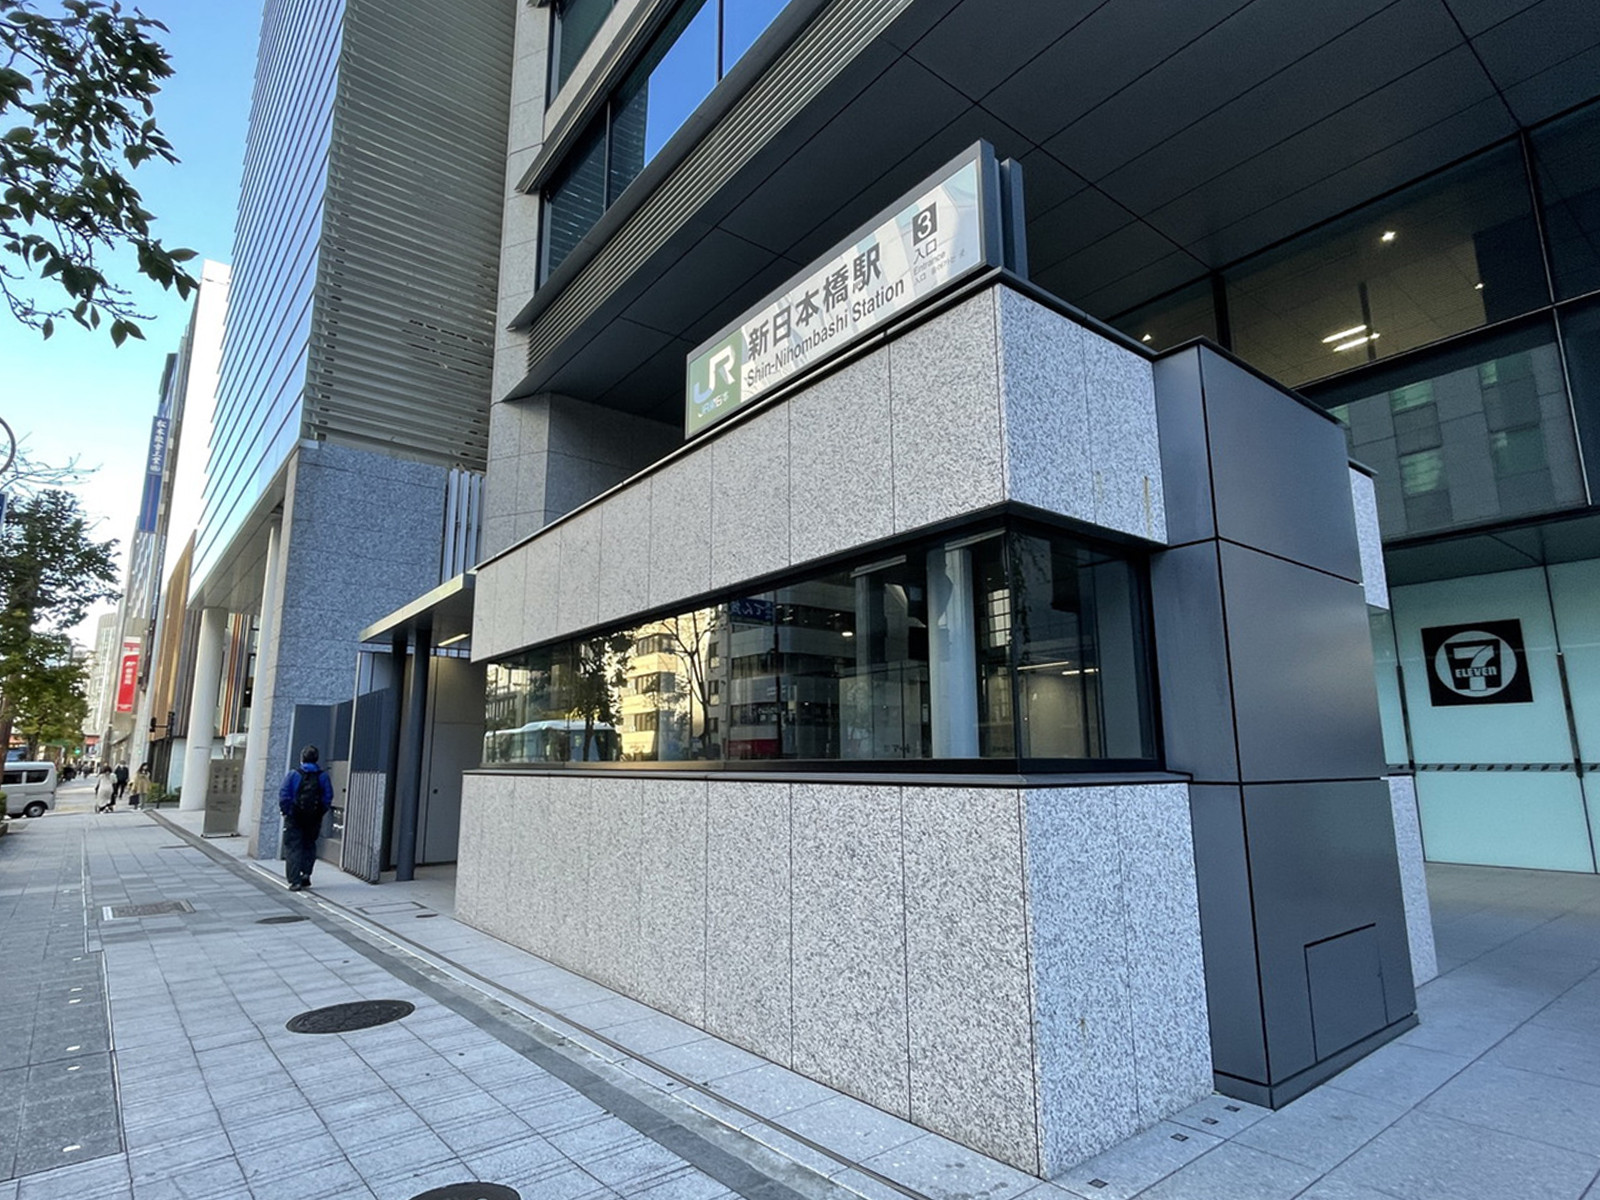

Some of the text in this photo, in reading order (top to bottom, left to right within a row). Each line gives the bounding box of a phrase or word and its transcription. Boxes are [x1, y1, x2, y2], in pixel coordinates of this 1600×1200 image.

[917, 210, 932, 239] 3
[913, 238, 937, 265] 入口
[914, 251, 946, 275] Entrance
[748, 242, 881, 361] 新日本橋駅
[747, 278, 905, 387] Shin-Nihombashi Station
[693, 345, 736, 404] JR
[1453, 644, 1495, 691] 7
